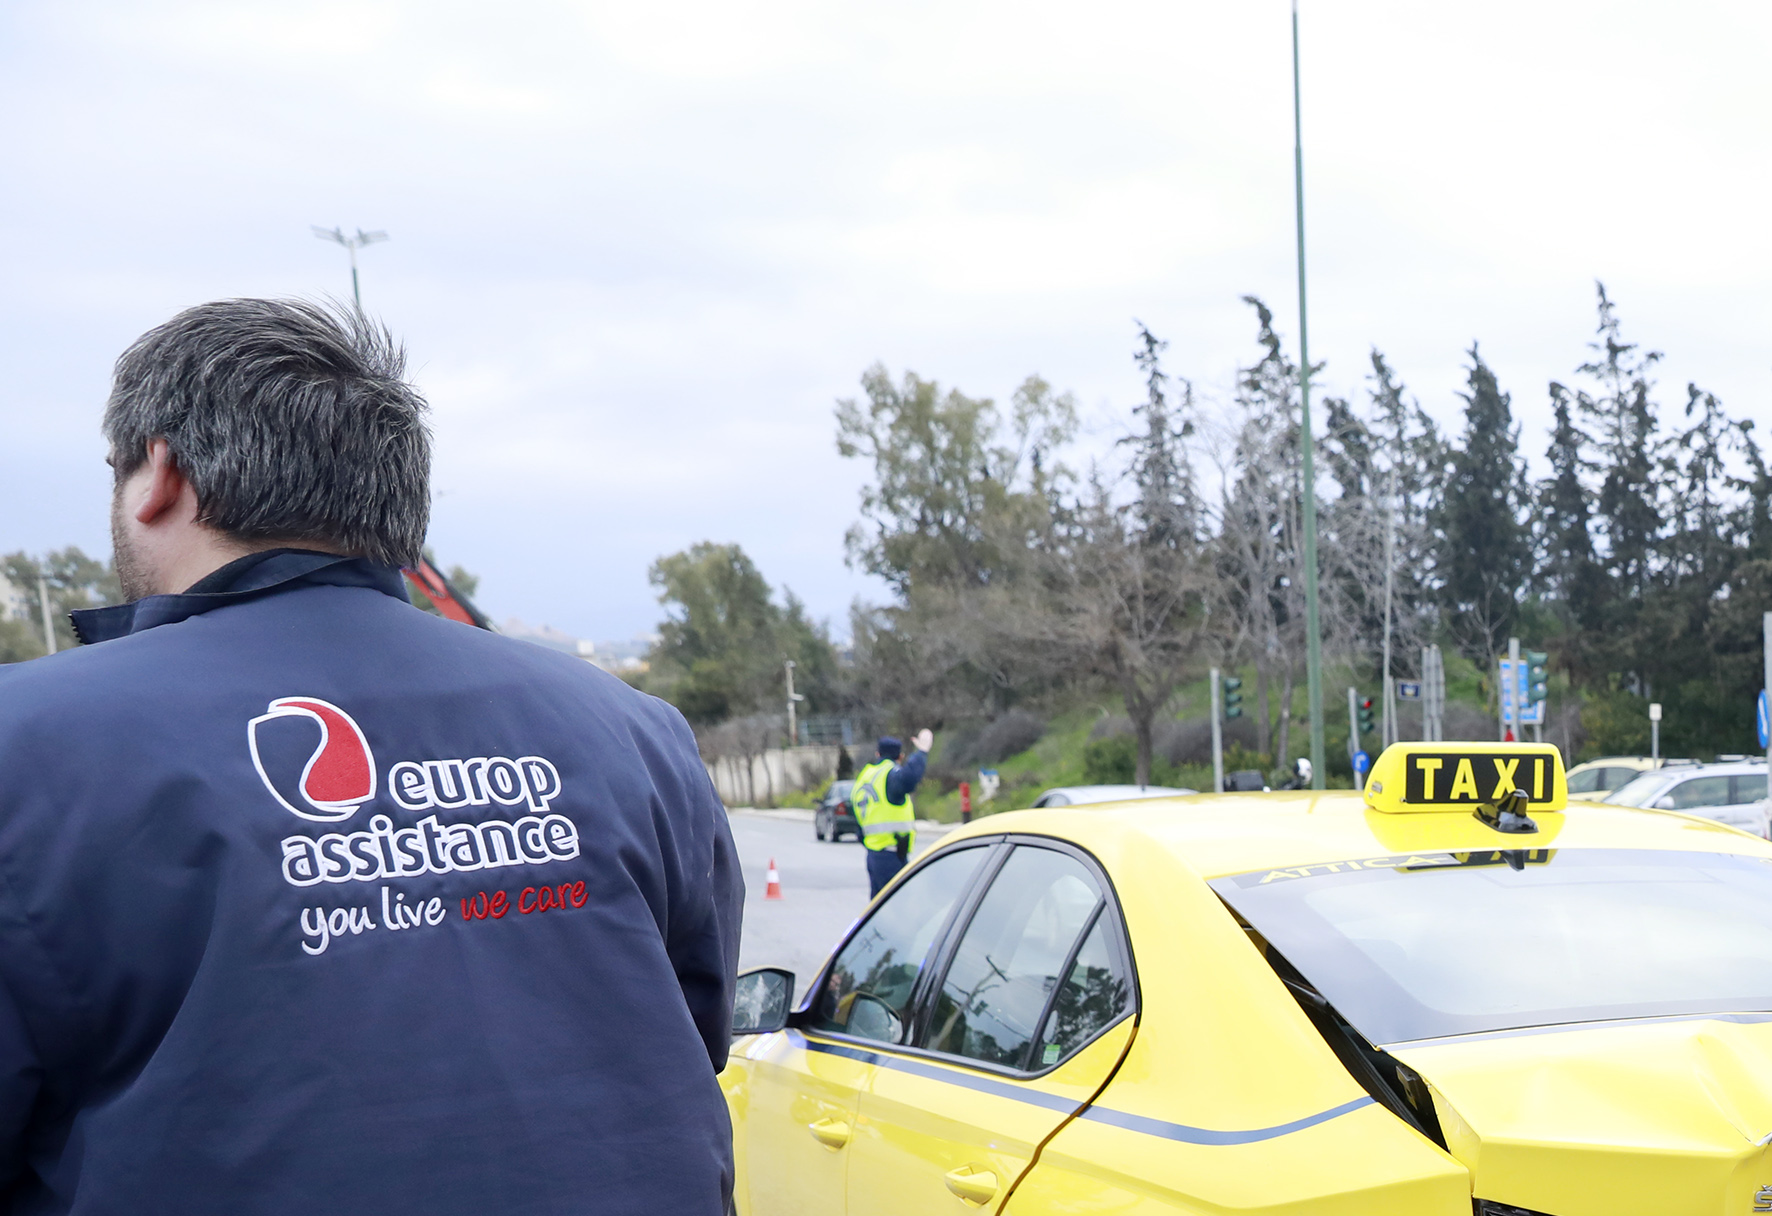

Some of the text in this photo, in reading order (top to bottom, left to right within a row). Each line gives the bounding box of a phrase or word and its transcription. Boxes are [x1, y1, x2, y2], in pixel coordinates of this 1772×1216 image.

[388, 756, 562, 812] europ
[1416, 757, 1545, 800] TAXI
[281, 814, 581, 887] assistance
[301, 880, 589, 956] you live we care
